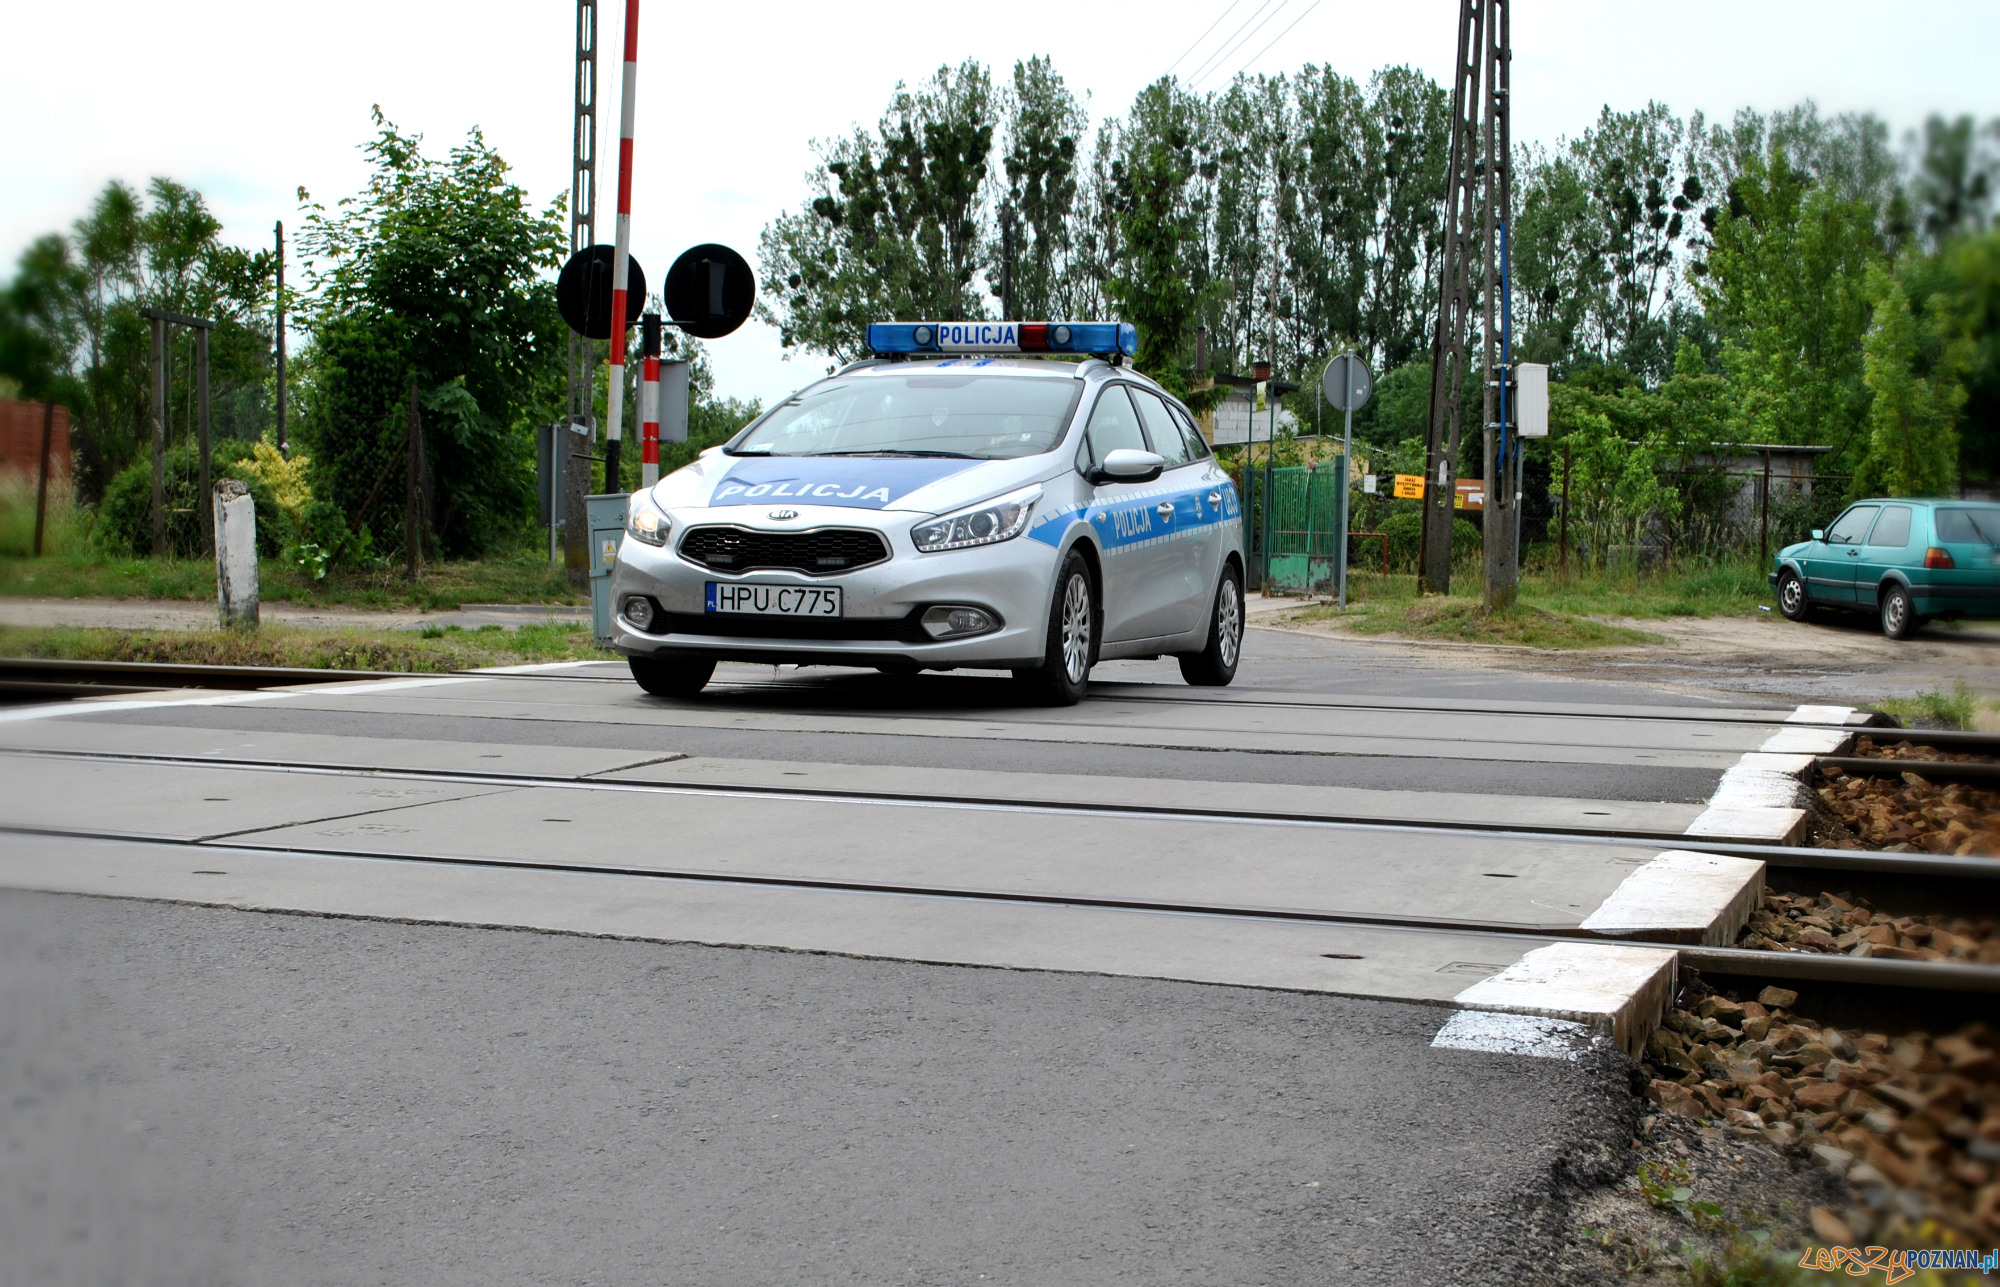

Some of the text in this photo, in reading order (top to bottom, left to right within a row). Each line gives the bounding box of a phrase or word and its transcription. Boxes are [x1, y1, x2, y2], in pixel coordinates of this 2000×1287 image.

[940, 326, 1016, 344] POLICJA
[715, 483, 890, 502] POLICJA
[771, 509, 795, 519] KIA
[1113, 505, 1152, 539] POLICJA
[707, 600, 716, 608] PL
[720, 586, 836, 614] HPU C775
